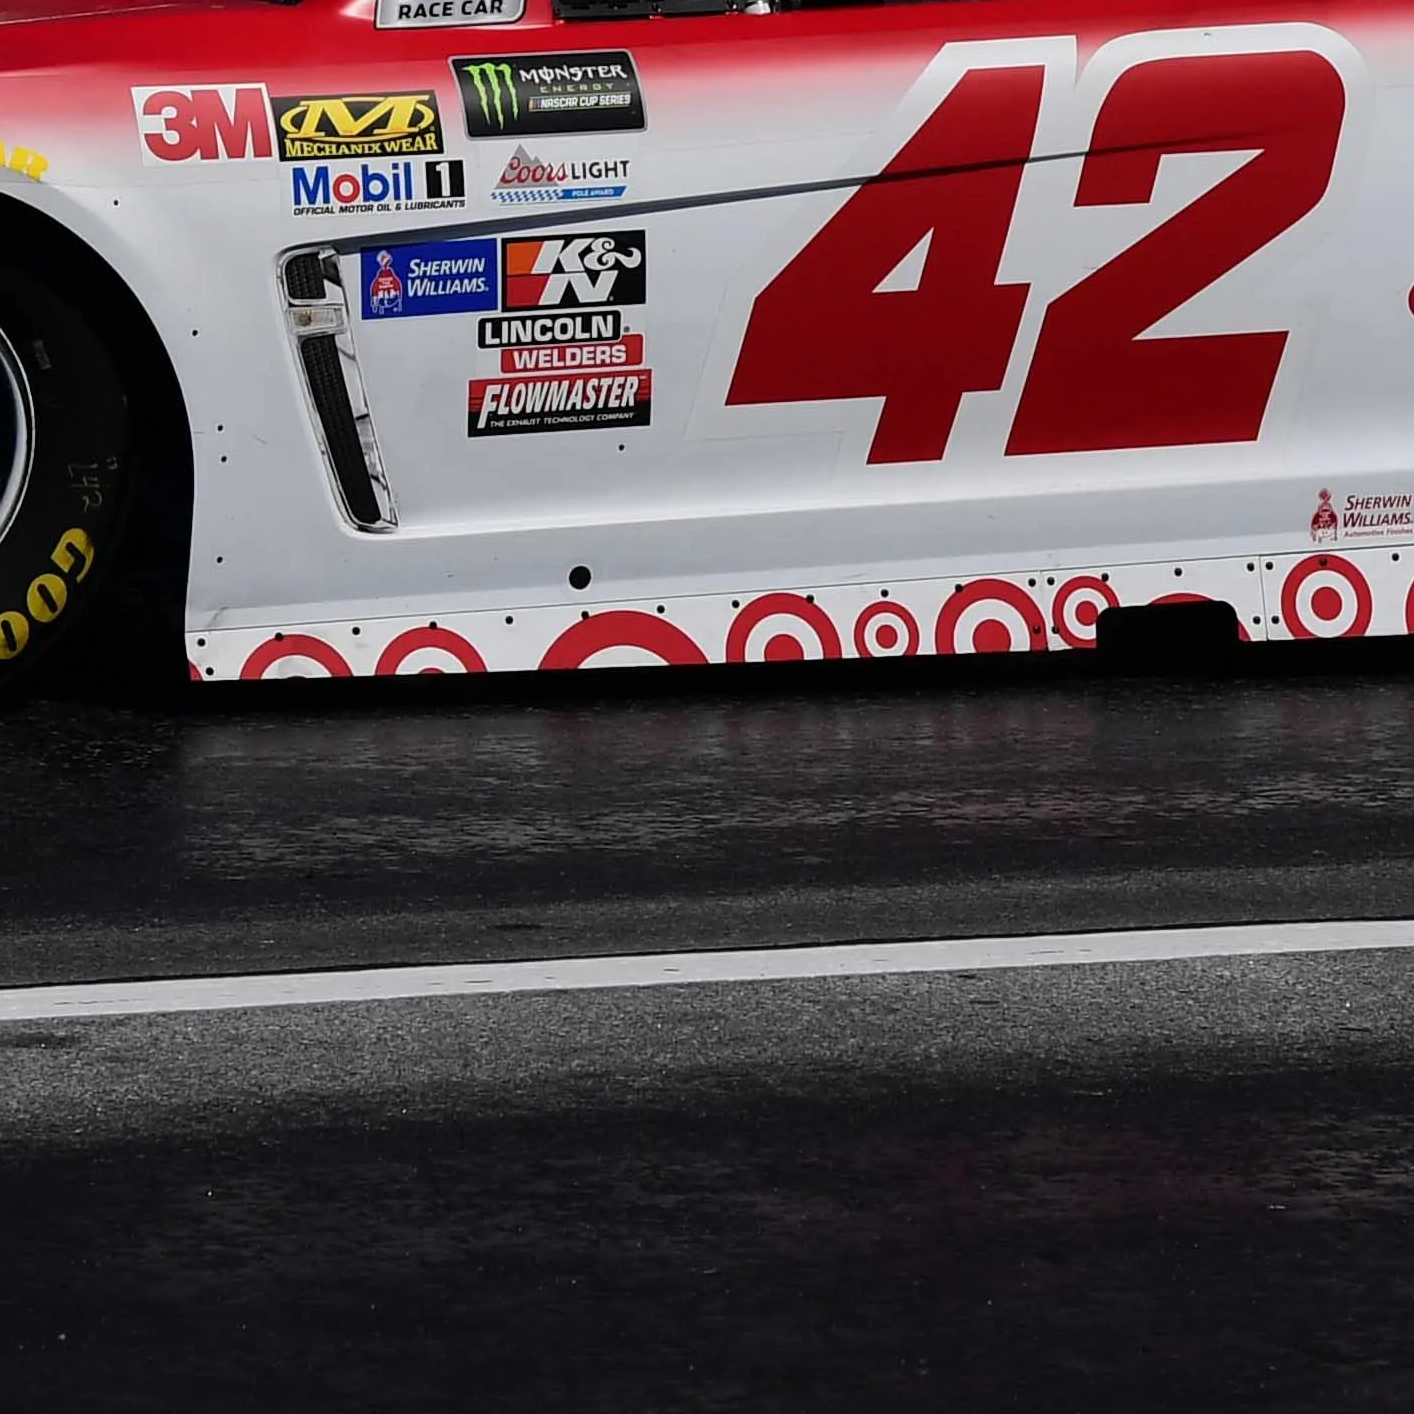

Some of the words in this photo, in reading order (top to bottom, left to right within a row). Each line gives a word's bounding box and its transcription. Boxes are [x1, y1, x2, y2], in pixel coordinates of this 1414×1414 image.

[397, 1, 453, 21] RACE
[539, 82, 615, 94] ENERGY
[540, 95, 579, 109] NASCAR
[580, 94, 599, 107] CUP
[599, 93, 632, 106] SERIES
[142, 87, 273, 162] 3M
[284, 138, 382, 158] MECHANIX
[383, 134, 439, 155] WEAR
[499, 155, 569, 185] Coors
[570, 159, 630, 180] LIGHT
[291, 161, 414, 206] Mobil
[293, 204, 336, 216] OFFICIAL
[338, 202, 374, 214] MOTOR
[376, 202, 392, 212] OIL
[404, 198, 466, 212] LUBRICANTS
[407, 257, 486, 278] SHERWIN
[724, 49, 1347, 465] 42
[407, 277, 487, 298] WILLIAMS
[484, 314, 615, 346] LINCOLN
[512, 344, 628, 371] WELDERS
[476, 375, 641, 430] FLOWMASTER
[489, 419, 505, 428] THE
[506, 417, 542, 427] EXHAUST
[543, 413, 596, 425] TECHNOLOGY
[596, 411, 636, 422] COMPANY
[1344, 493, 1414, 512] SHERWIN
[1341, 511, 1412, 529] WILLIAMS
[1343, 528, 1385, 539] Automotive
[1385, 527, 1414, 537] Finishes
